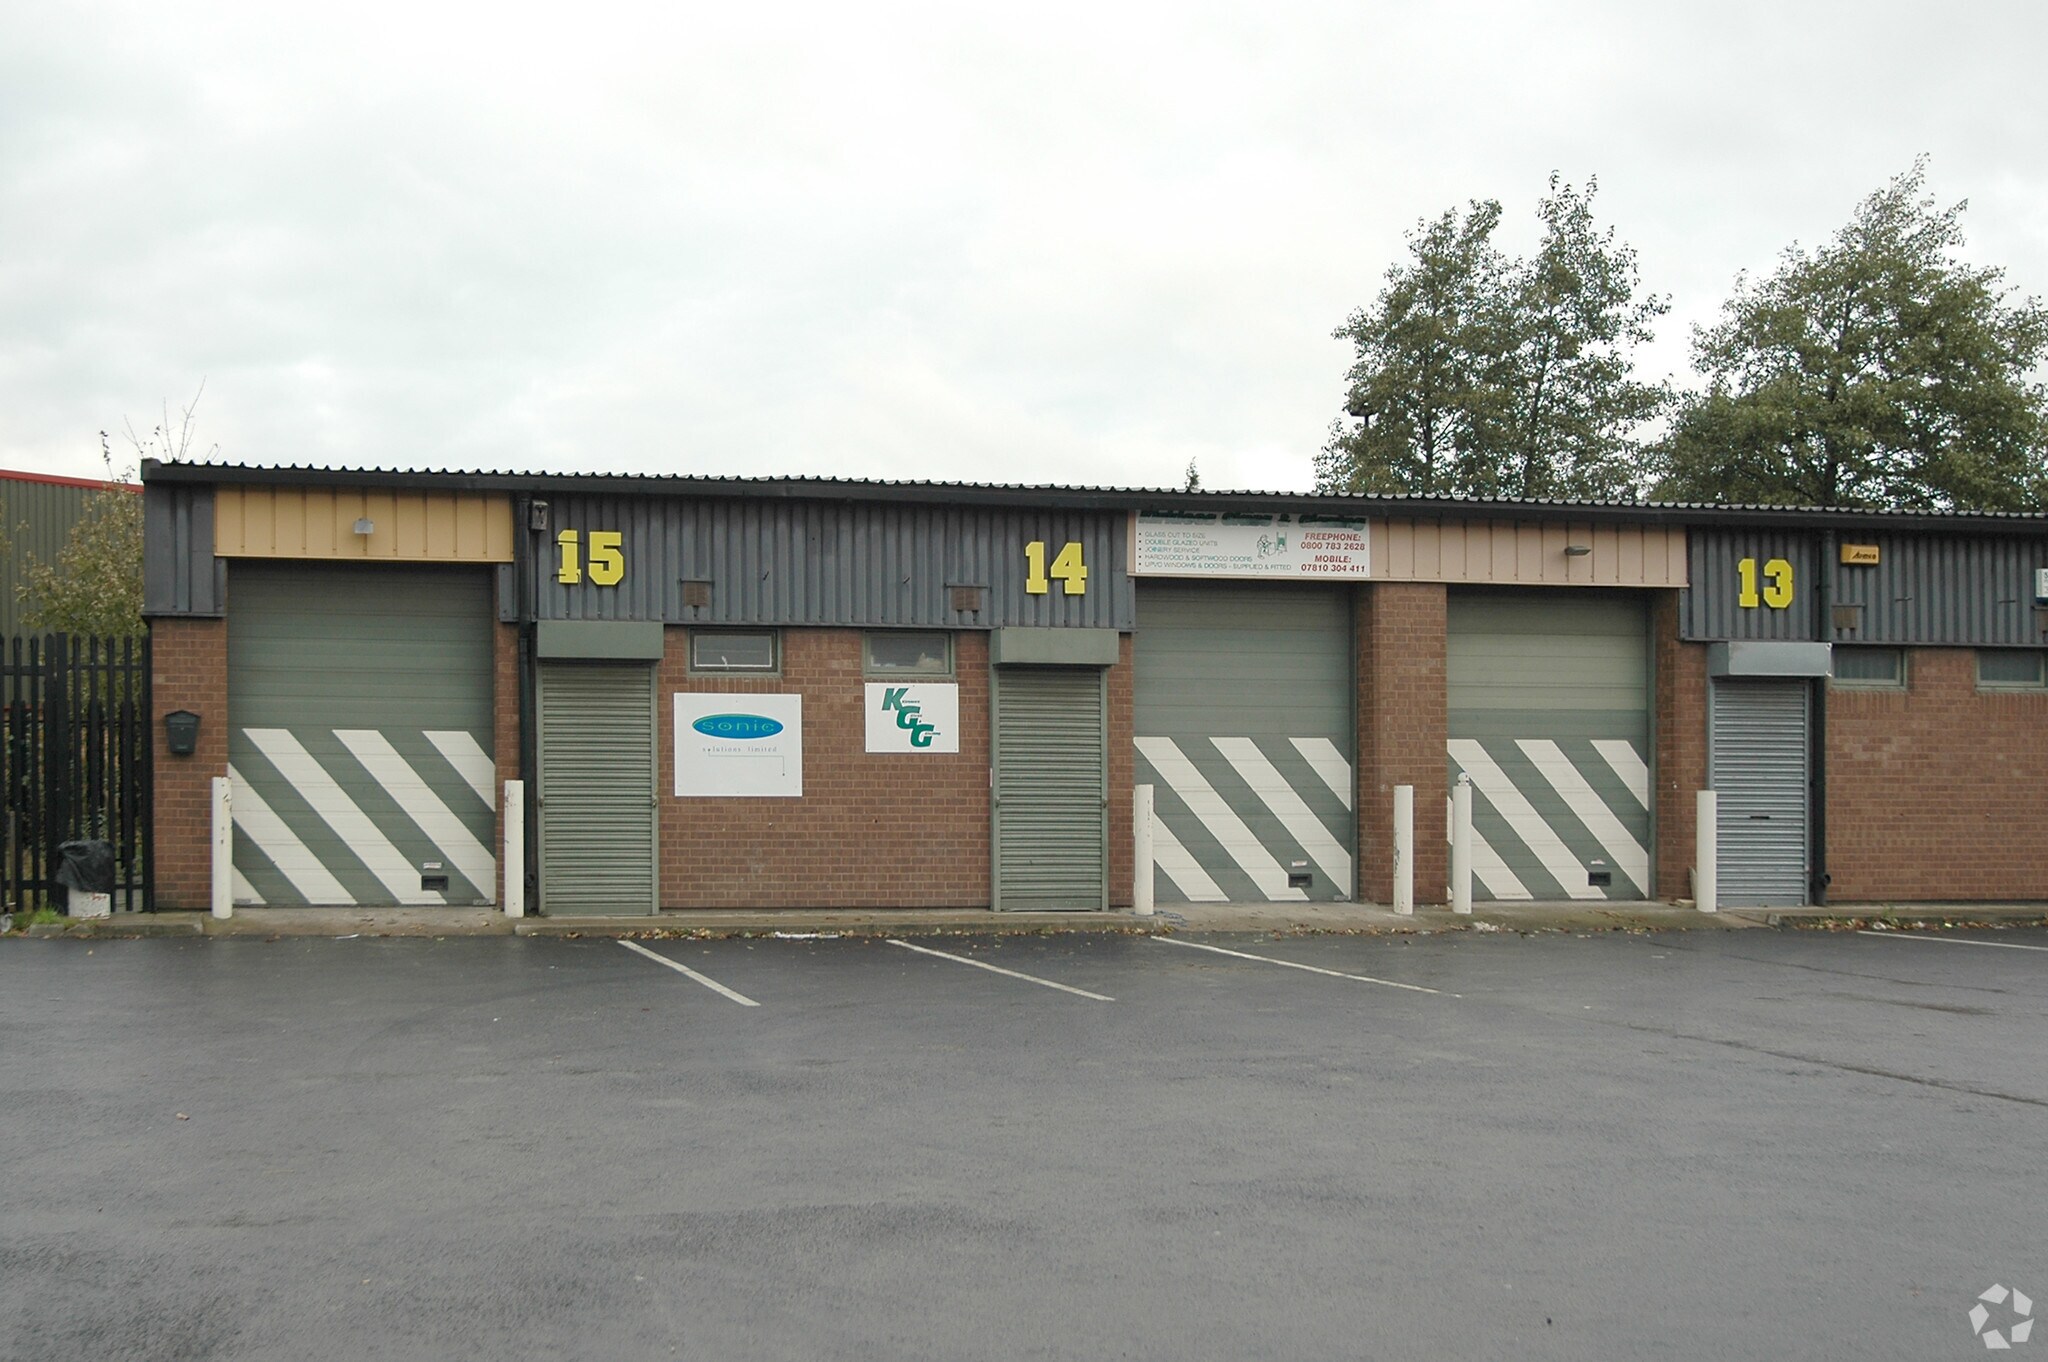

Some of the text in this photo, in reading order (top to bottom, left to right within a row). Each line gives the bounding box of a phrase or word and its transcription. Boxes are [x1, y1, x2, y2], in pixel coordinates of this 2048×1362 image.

[1304, 532, 1361, 542] FREEPHONE:
[1300, 542, 1365, 551] 0800 783 2628
[558, 529, 624, 586] 15
[1314, 555, 1352, 564] MOBILE:
[1025, 541, 1087, 594] 14
[1301, 564, 1328, 572] 07810
[1738, 558, 1792, 607] 13
[702, 720, 775, 732] sonic
